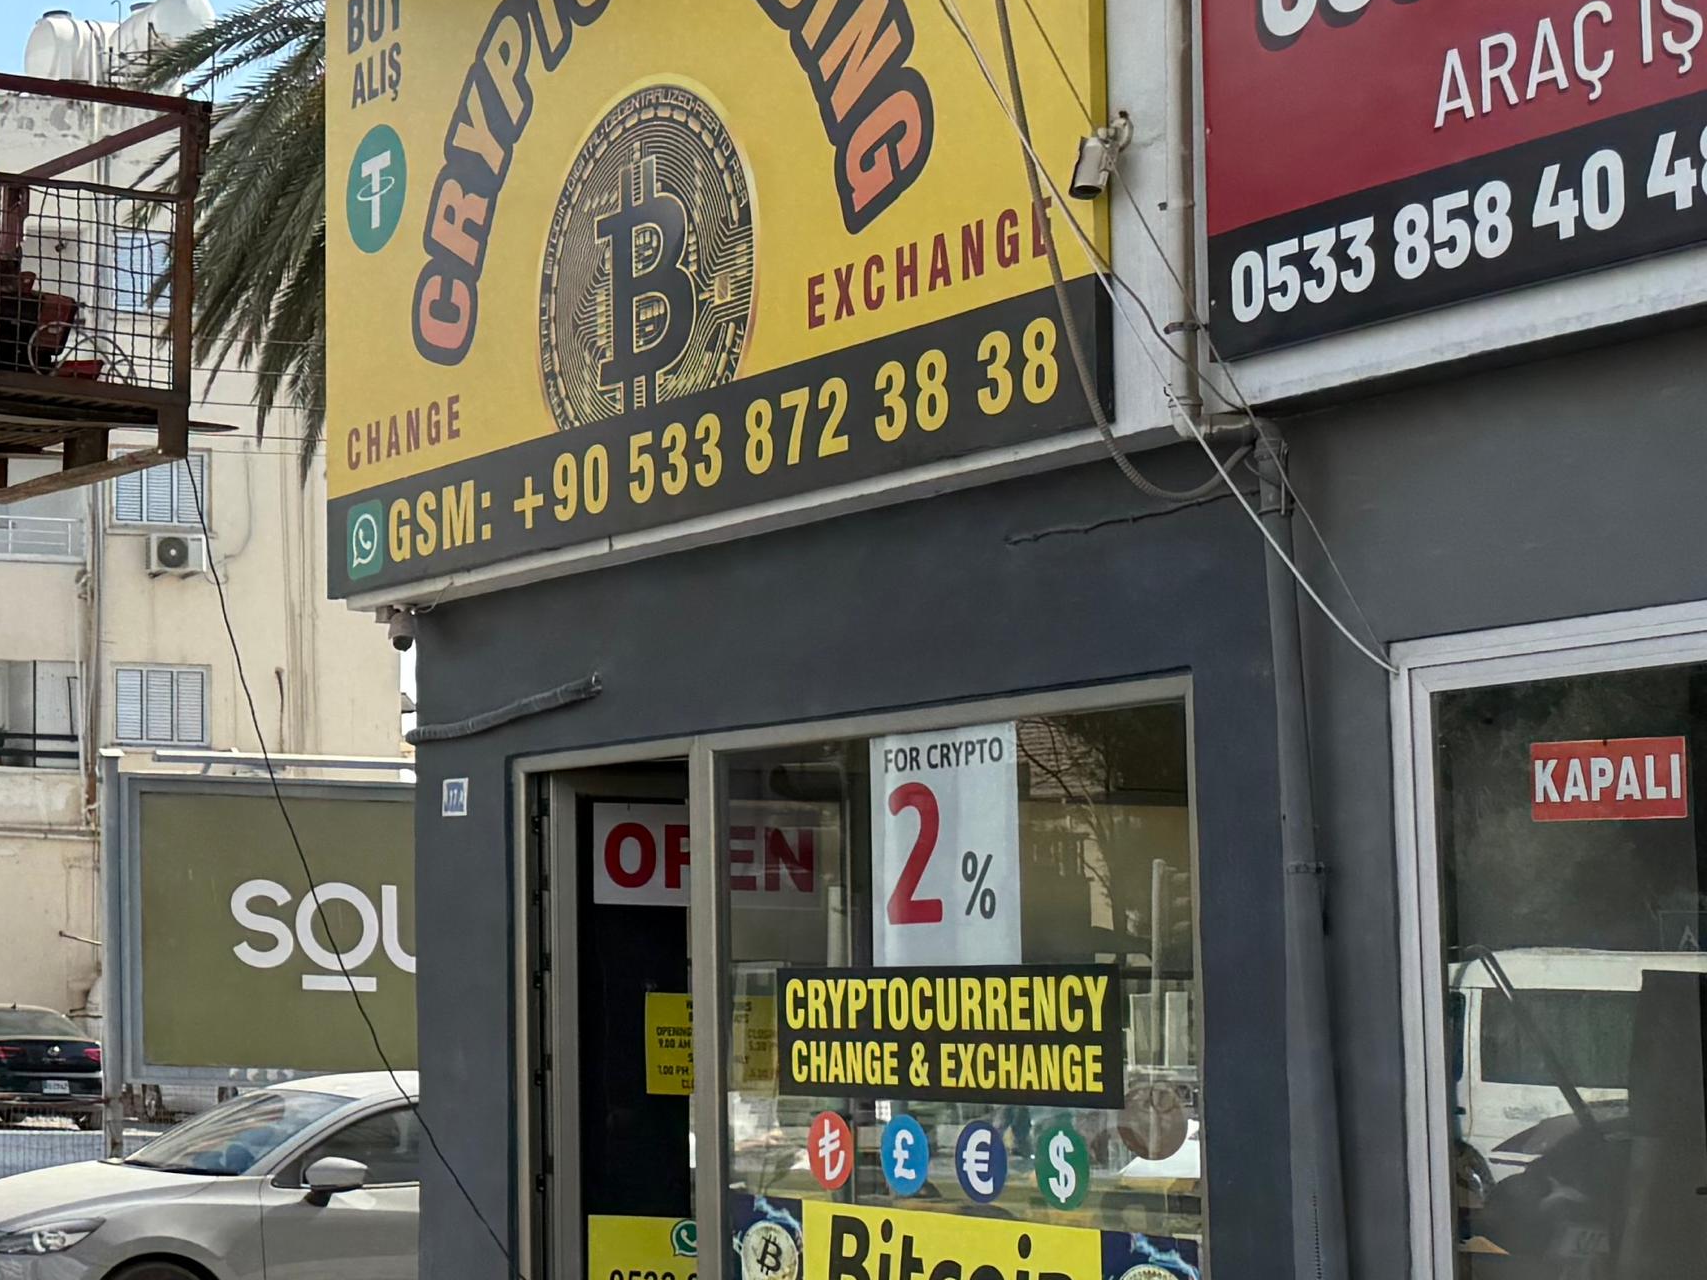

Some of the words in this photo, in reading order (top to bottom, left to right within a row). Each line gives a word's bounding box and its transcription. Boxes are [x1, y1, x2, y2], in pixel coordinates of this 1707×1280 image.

[351, 42, 402, 110] ALIŞ
[1434, 0, 1614, 129] ARAÇ
[1231, 216, 1377, 323] 0533
[1393, 180, 1513, 280] 858
[1532, 149, 1626, 241] 40
[1647, 125, 1707, 211] 4
[807, 196, 1052, 330] EXCHANGE
[347, 395, 461, 471] CHANGE
[389, 480, 492, 563] GSM:
[513, 443, 609, 529] +90
[628, 413, 723, 505] 533
[745, 377, 849, 475] 872
[875, 349, 949, 442] 38
[977, 317, 1059, 415] 38
[884, 746, 921, 773] FOR
[927, 736, 1004, 770] CRYPTO
[1535, 754, 1682, 804] KAPALI
[604, 822, 815, 893] OPEN
[887, 781, 943, 926] 2
[961, 851, 997, 920] %
[785, 975, 1108, 1033] CRYPTOCURRENCY
[791, 1040, 899, 1087] CHANGE
[908, 1041, 931, 1088] &
[940, 1042, 1104, 1094] EXCHANGE
